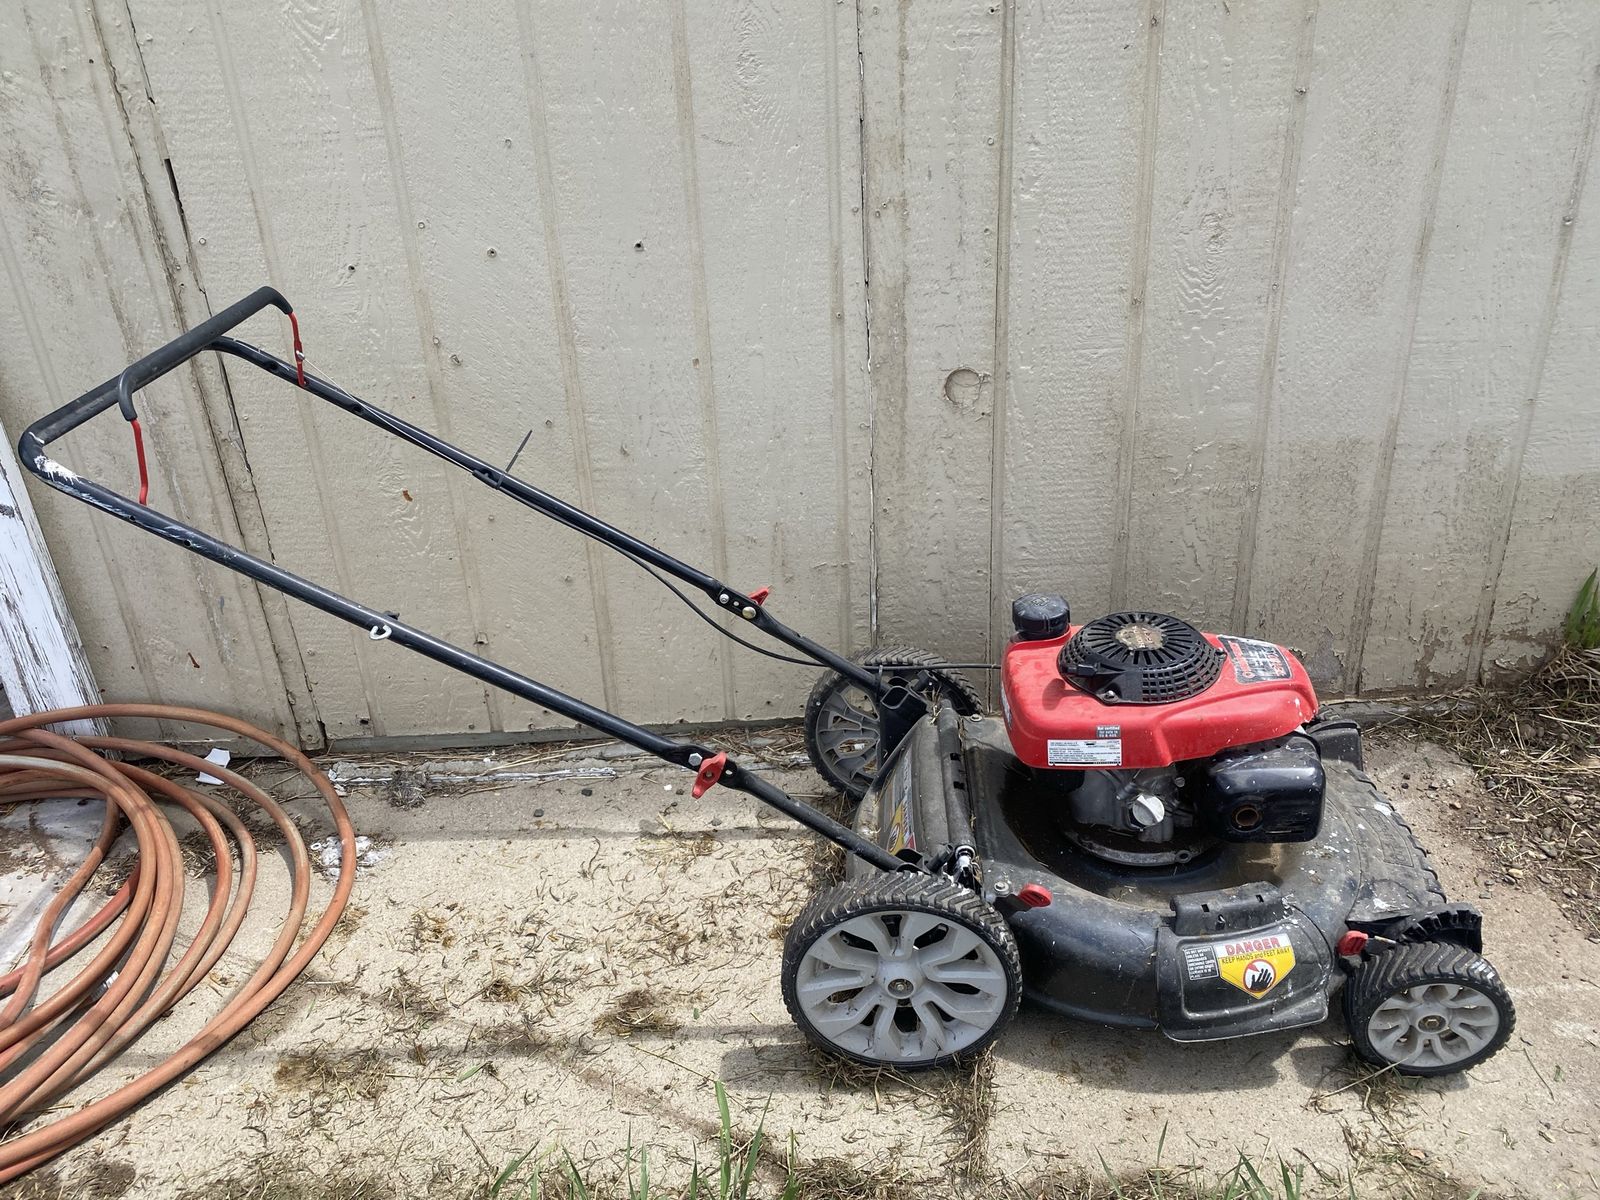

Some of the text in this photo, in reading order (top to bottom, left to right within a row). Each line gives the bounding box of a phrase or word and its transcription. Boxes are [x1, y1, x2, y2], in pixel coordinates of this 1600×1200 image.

[1225, 937, 1280, 956] DANGER
[1236, 953, 1253, 962] HANDS
[1263, 949, 1276, 958] FEET
[1276, 947, 1290, 955] AWAY
